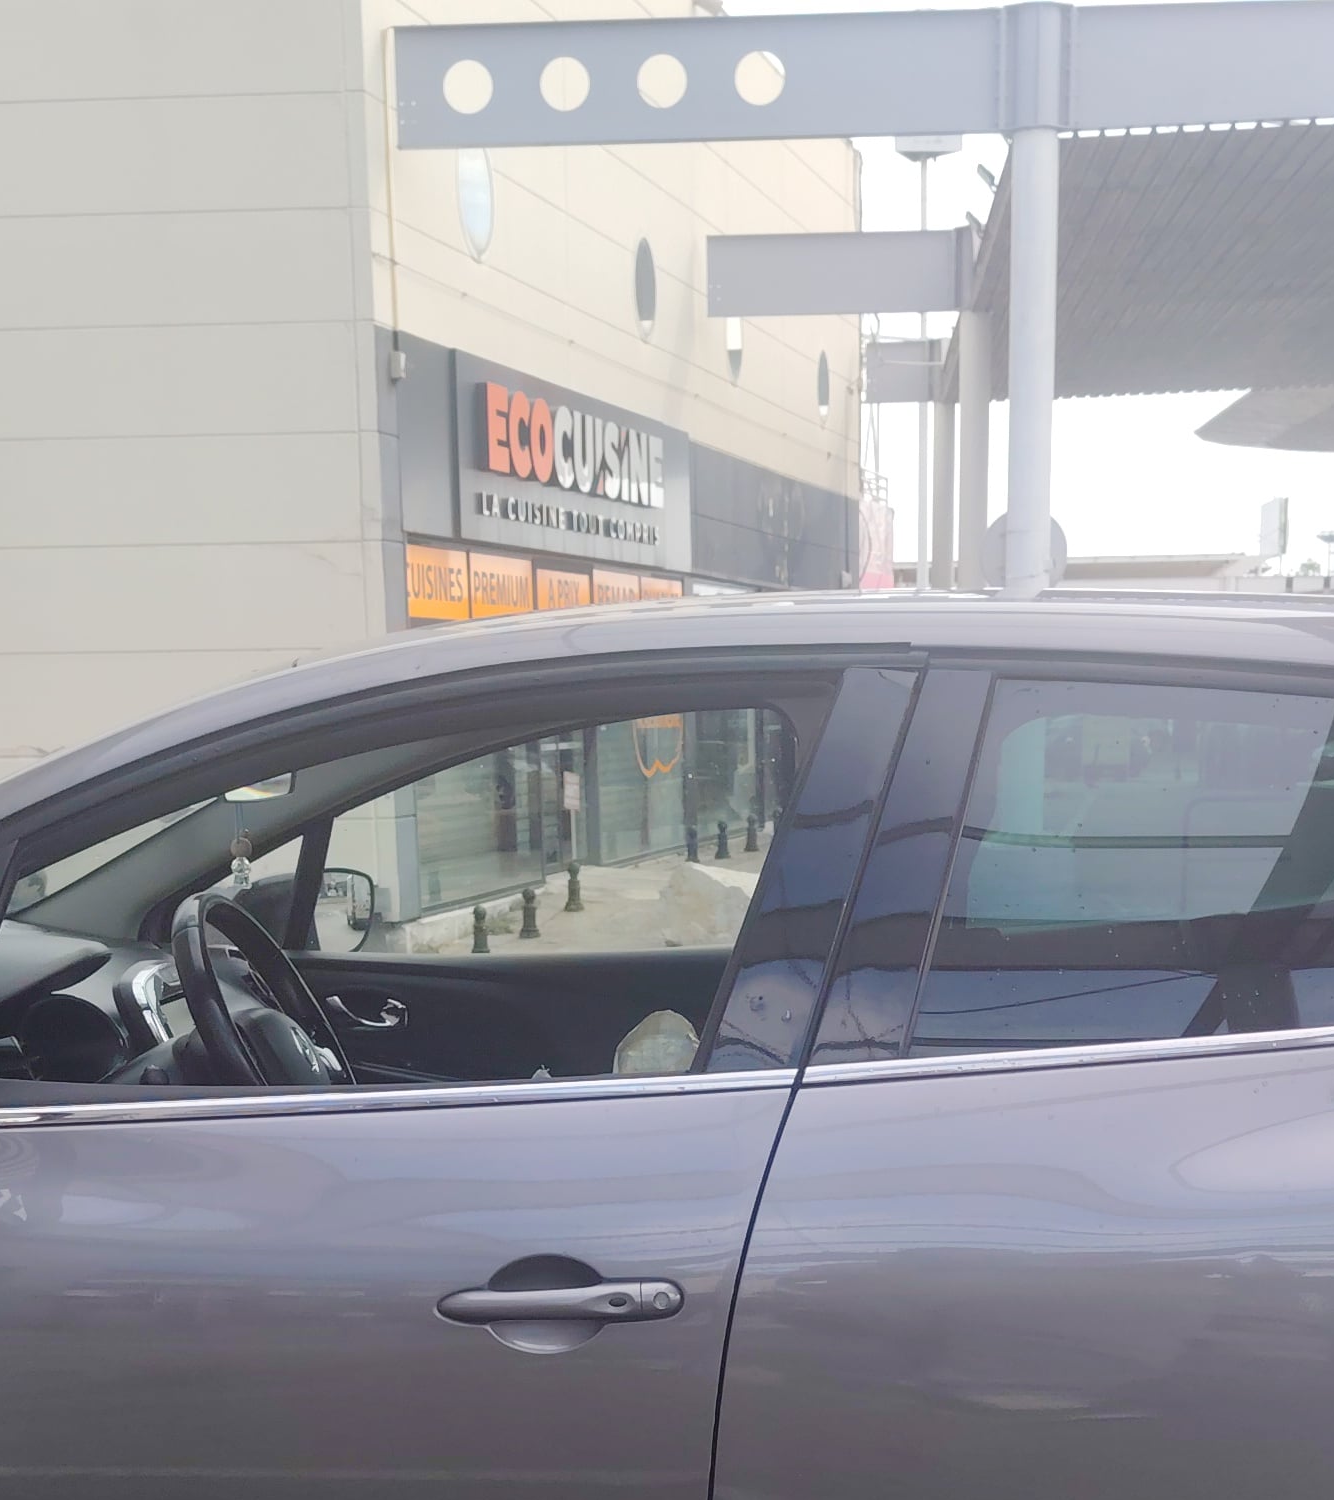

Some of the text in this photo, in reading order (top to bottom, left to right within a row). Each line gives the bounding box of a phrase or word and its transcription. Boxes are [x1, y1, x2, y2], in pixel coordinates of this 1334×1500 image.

[481, 491, 660, 546] LA CUISINE TOUT COMPRIS
[473, 570, 531, 609] PREMIUM
